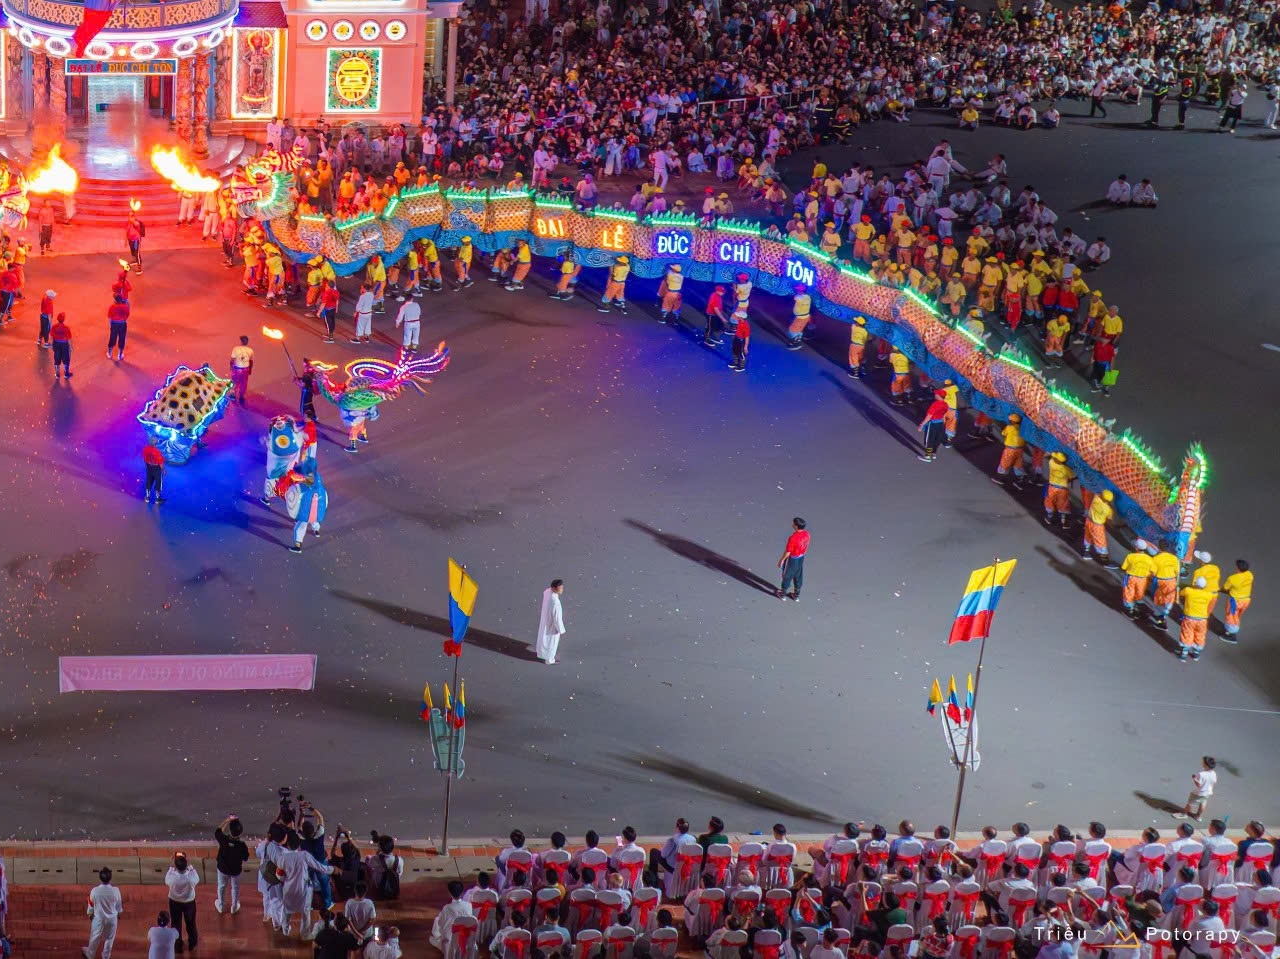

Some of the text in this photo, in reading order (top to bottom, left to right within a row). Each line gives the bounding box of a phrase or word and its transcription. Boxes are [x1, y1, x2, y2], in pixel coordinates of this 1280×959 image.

[657, 230, 689, 254] ĐỨC
[720, 241, 750, 263] CHÍ
[786, 259, 814, 286] TÔN
